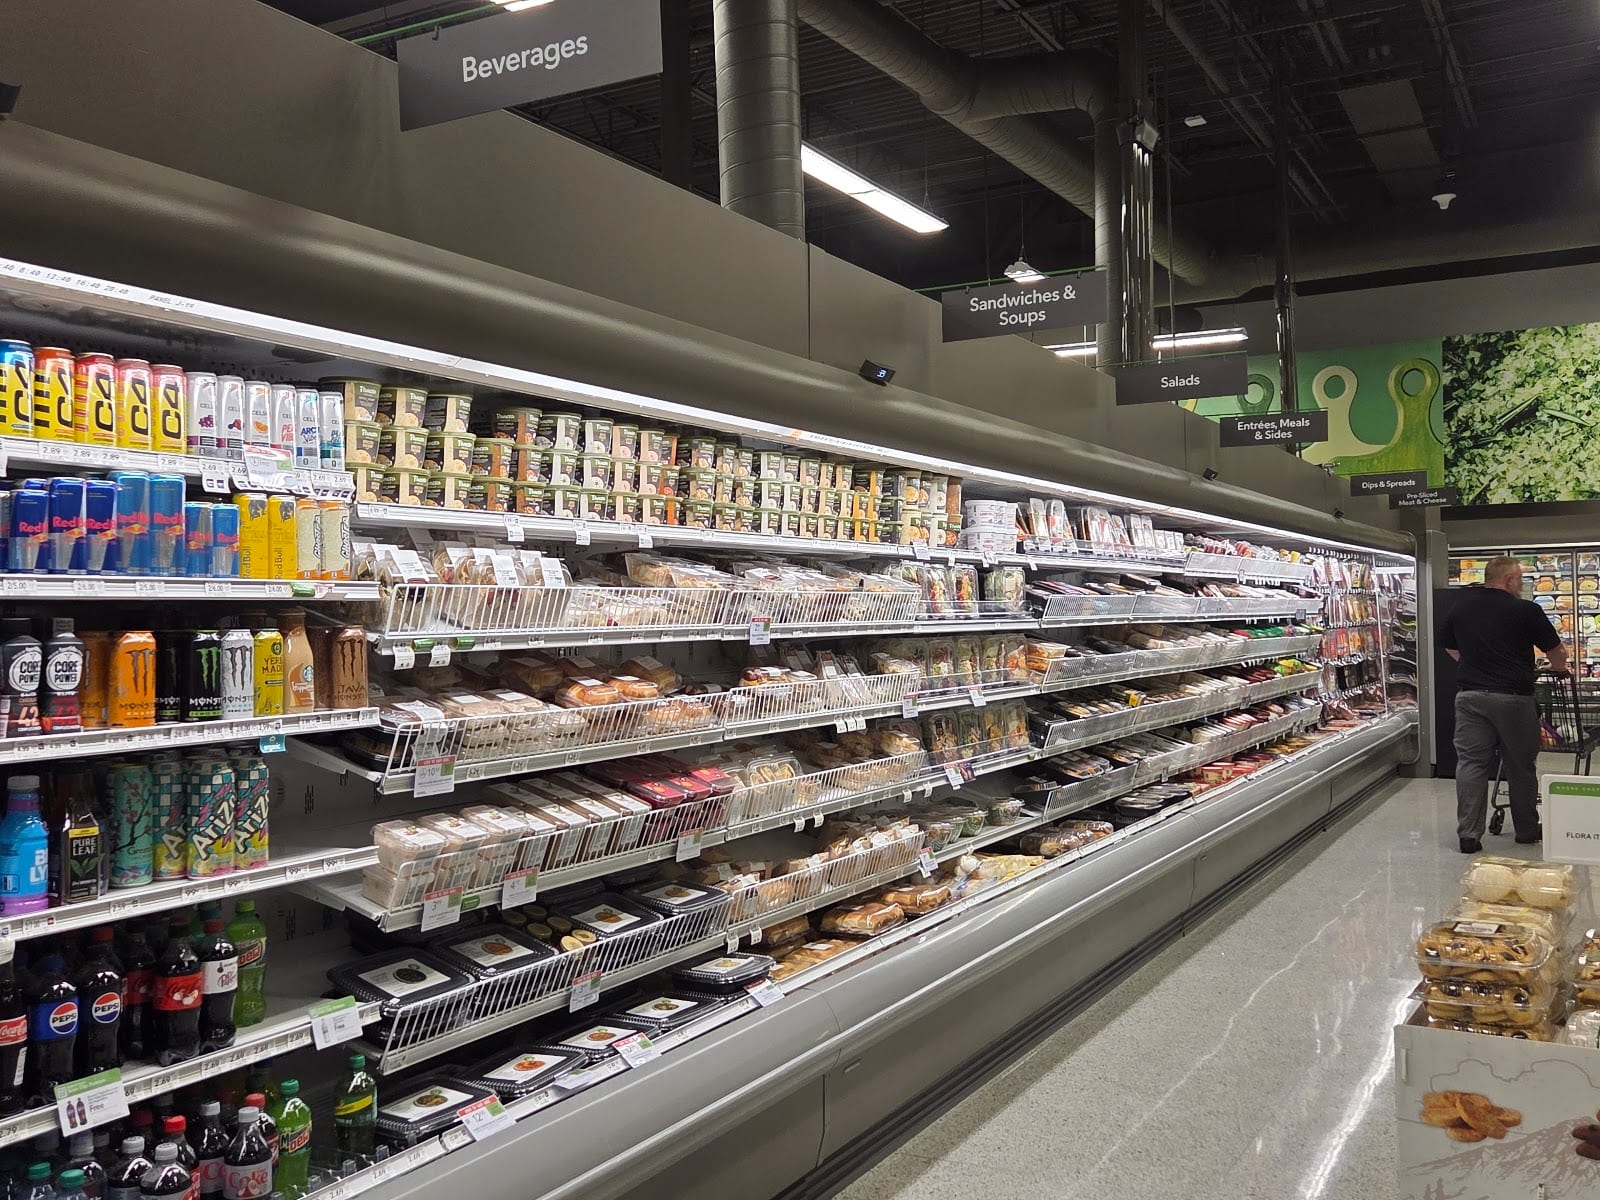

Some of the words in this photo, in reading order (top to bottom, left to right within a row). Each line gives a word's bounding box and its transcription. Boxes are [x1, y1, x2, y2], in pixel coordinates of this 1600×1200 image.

[462, 35, 588, 82] Beverages
[969, 286, 1060, 312] Sandwiches
[1063, 285, 1076, 299] &
[999, 308, 1046, 326] Soups
[1161, 374, 1200, 388] Salads
[131, 377, 149, 436] C4
[162, 381, 182, 440] C4
[1237, 418, 1278, 432] Entrées,
[1280, 417, 1310, 429] Meals
[1254, 431, 1264, 440] &
[1265, 427, 1293, 439] Sides
[1362, 481, 1378, 490] Dips
[1386, 479, 1415, 488] Spreads
[1406, 491, 1437, 499] Pre-Sliced
[1423, 497, 1447, 505] Cheese
[19, 521, 42, 532] Red
[52, 516, 76, 528] Red
[20, 661, 40, 673] CORE
[54, 661, 77, 673] CORE
[19, 674, 40, 684] POWE
[54, 673, 77, 683] POWER
[72, 837, 96, 847] PURE
[1566, 832, 1592, 840] FLORA
[72, 846, 96, 856] LEAF
[89, 1103, 105, 1113] Free
[227, 1168, 268, 1193] Coke
